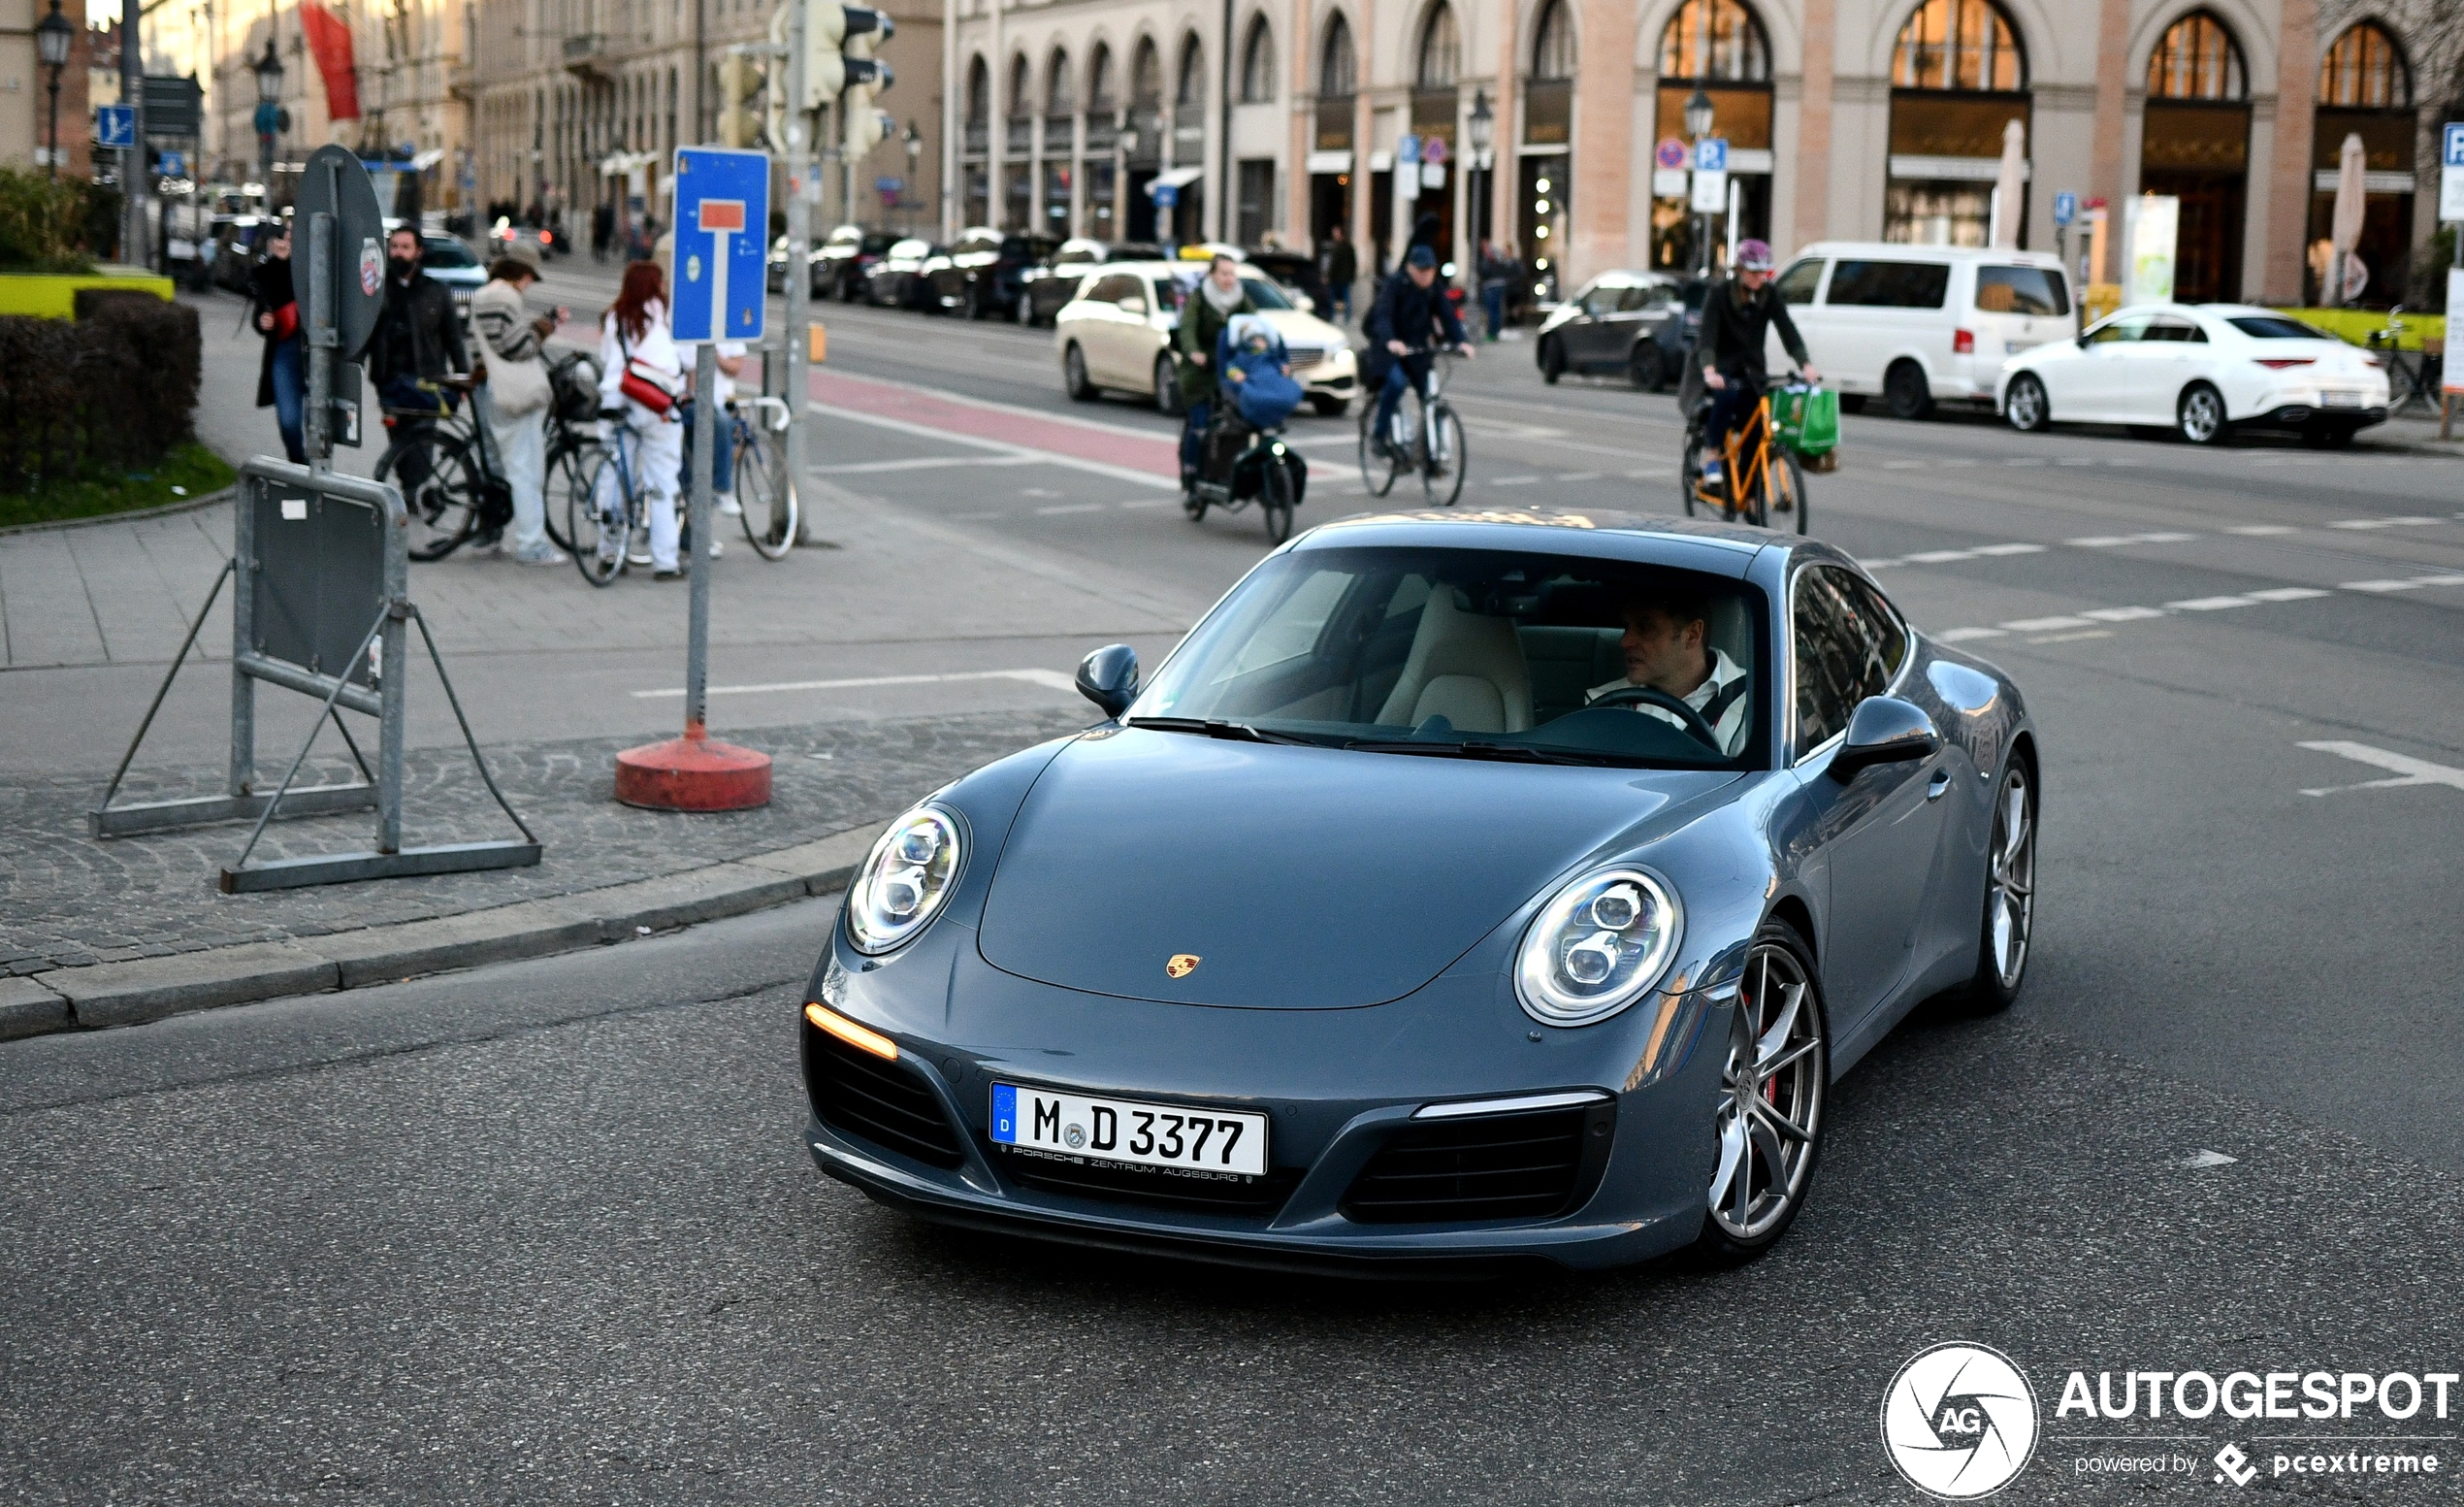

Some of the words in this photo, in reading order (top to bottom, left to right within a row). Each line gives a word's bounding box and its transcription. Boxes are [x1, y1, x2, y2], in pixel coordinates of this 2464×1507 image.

[1000, 1119, 1010, 1132] D
[1034, 1097, 1060, 1143] M
[1091, 1106, 1118, 1151] D
[1130, 1111, 1244, 1164] 3377
[1013, 1147, 1085, 1164] PORSCHE
[1090, 1159, 1156, 1174] ZENTRUM
[1162, 1167, 1239, 1183] AUGSBURG
